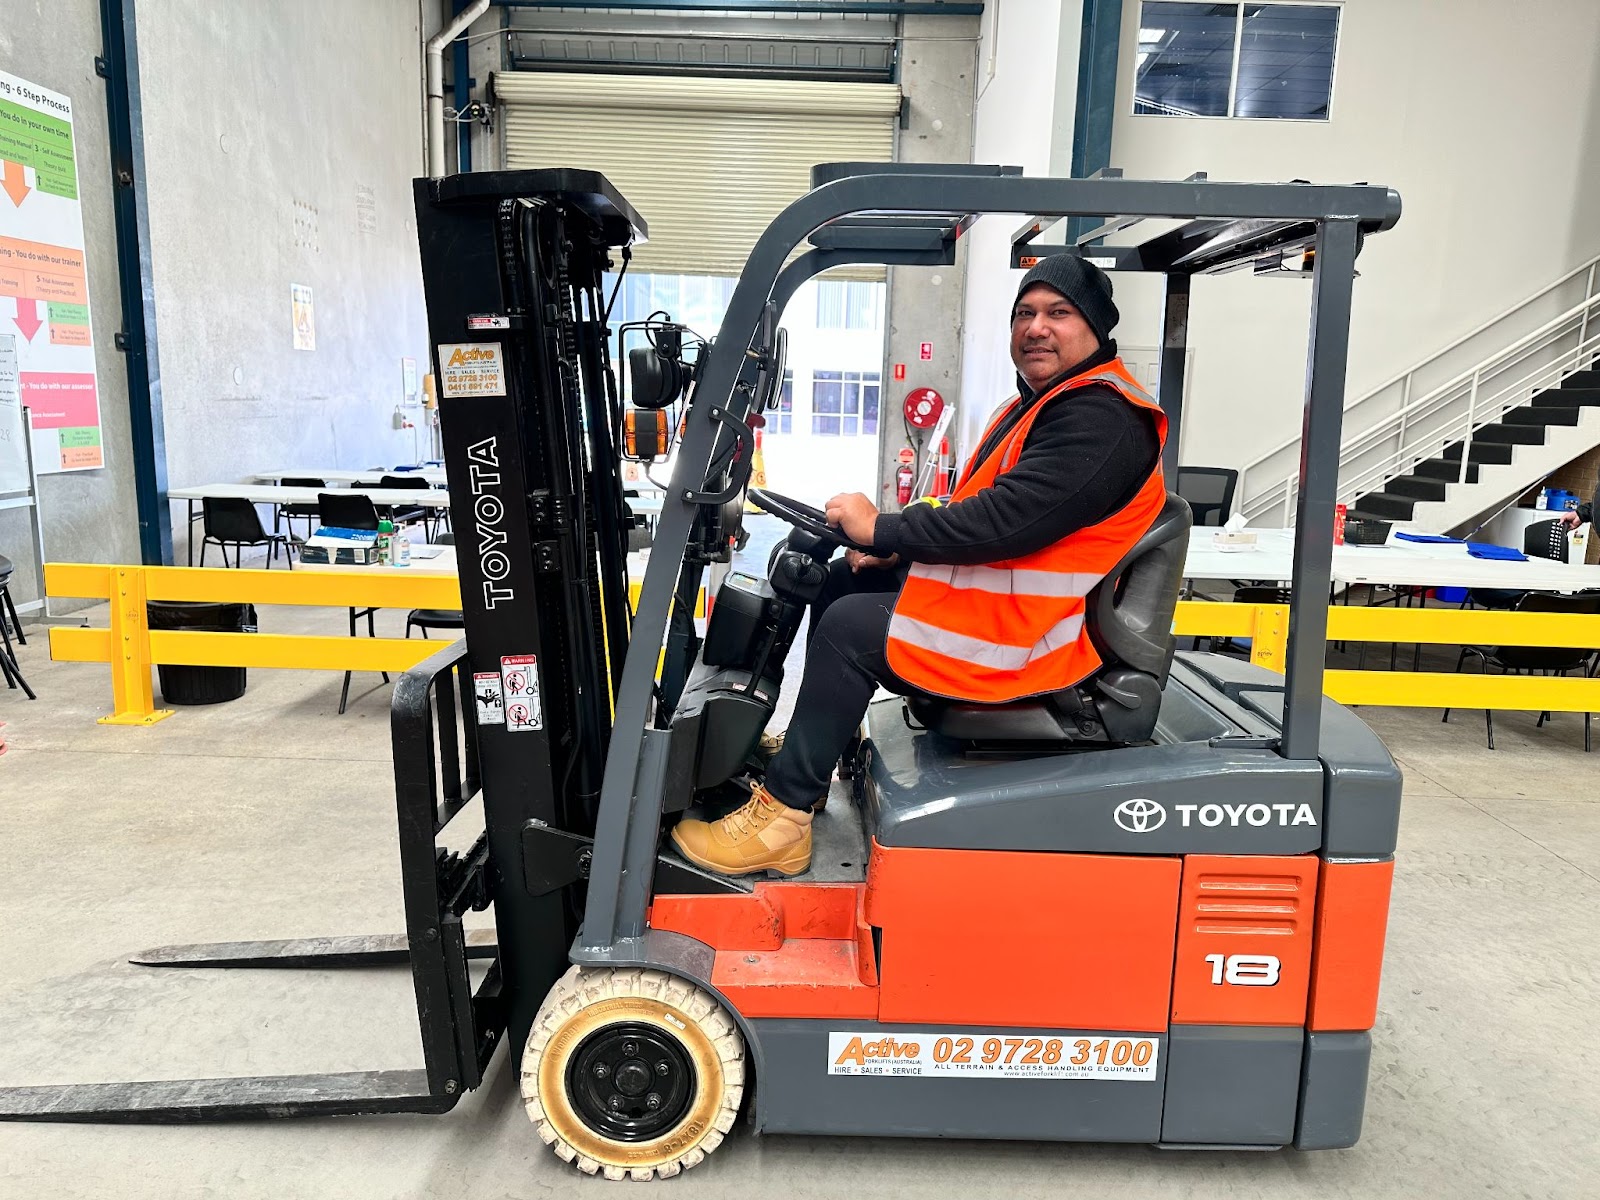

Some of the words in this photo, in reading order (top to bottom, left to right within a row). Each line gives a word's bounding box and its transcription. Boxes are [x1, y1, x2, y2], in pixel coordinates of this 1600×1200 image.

[16, 86, 22, 96] 6
[23, 88, 41, 104] Step
[41, 95, 70, 113] Process
[0, 109, 11, 120] You
[11, 113, 20, 123] do
[20, 116, 28, 125] in
[27, 120, 42, 130] your
[42, 126, 56, 135] own
[55, 128, 69, 139] time
[34, 144, 39, 152] 3
[15, 249, 28, 258] You
[28, 252, 36, 260] do
[36, 253, 50, 262] with
[61, 258, 81, 267] trainer
[51, 279, 75, 287] Assessment
[447, 347, 495, 367] Active
[29, 382, 40, 390] You
[49, 382, 61, 390] with
[447, 375, 458, 383] 02
[448, 383, 467, 391] 0411
[467, 436, 514, 610] TOYOTA
[1175, 803, 1318, 827] TOYOTA
[1204, 953, 1282, 987] 18
[834, 1036, 921, 1066] Active
[932, 1036, 975, 1063] 02
[981, 1037, 1064, 1065] 9728
[1070, 1038, 1154, 1067] 3100
[834, 1066, 852, 1074] HIRE
[860, 1066, 883, 1074] SALES
[892, 1067, 922, 1075] SERVICE
